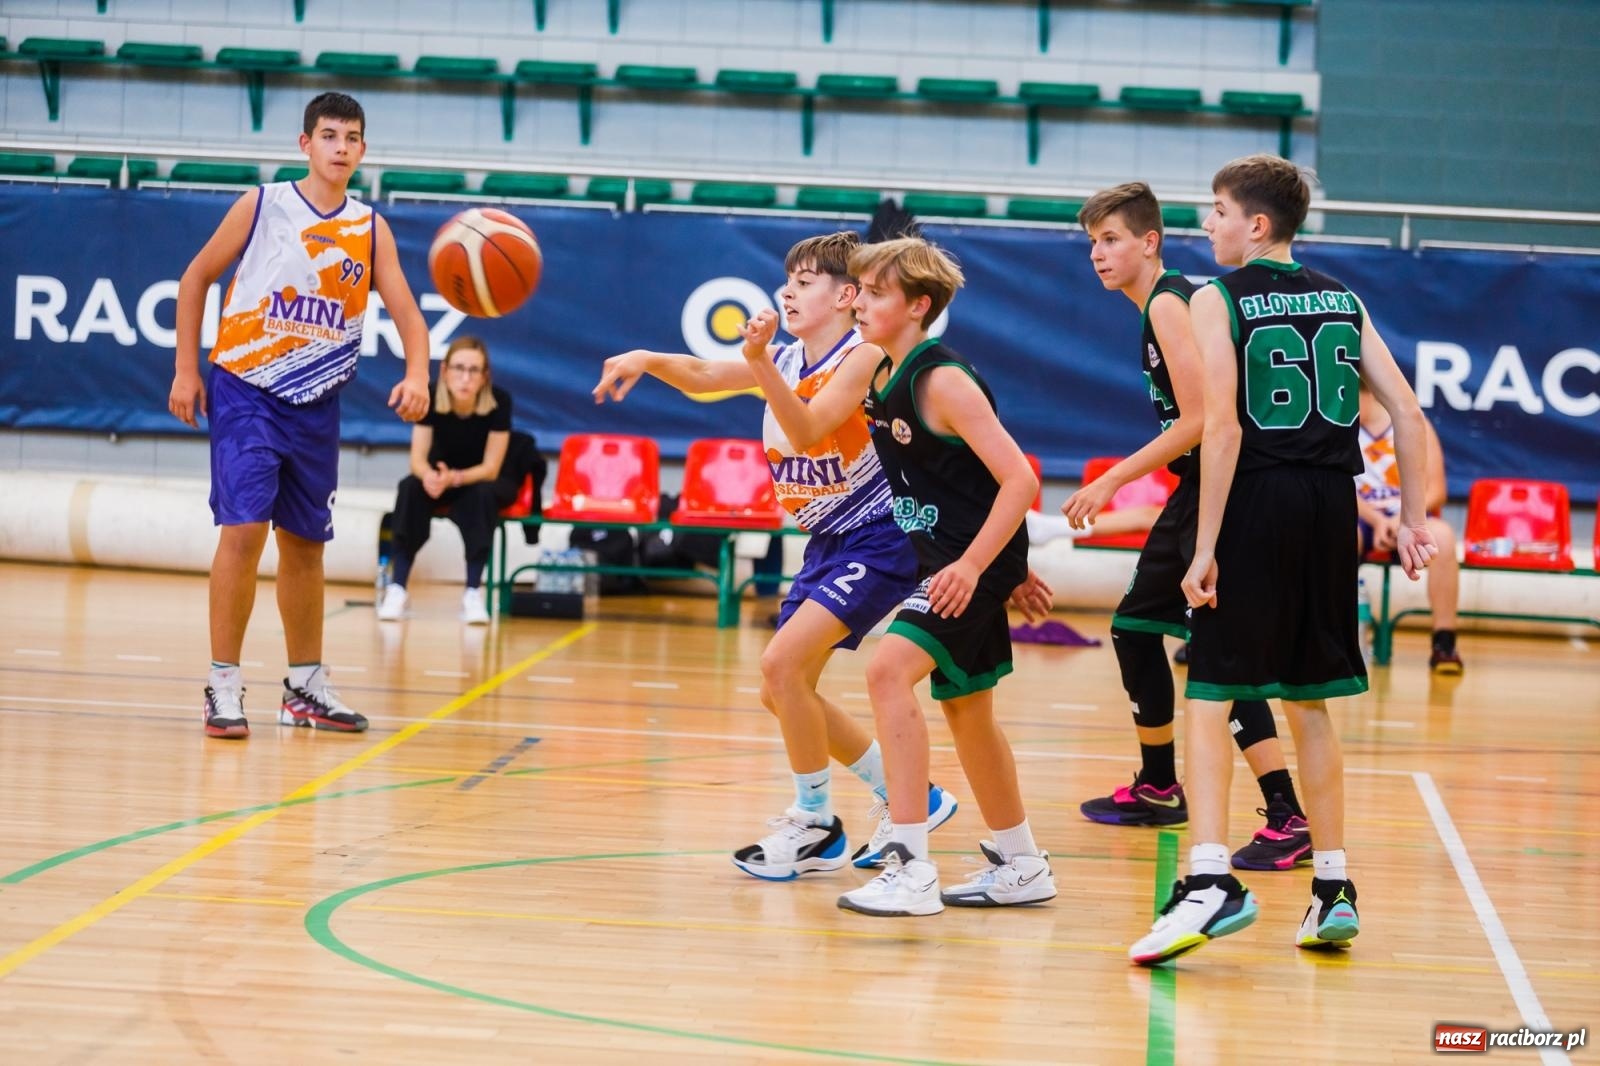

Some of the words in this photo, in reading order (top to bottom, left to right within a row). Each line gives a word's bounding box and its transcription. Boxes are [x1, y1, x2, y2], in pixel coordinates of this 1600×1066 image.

[340, 257, 364, 286] 99
[14, 274, 468, 360] RACIRZ
[267, 318, 344, 341] BASKETBALL
[1245, 321, 1361, 430] 66
[833, 562, 867, 594] 2
[818, 585, 848, 606] regio
